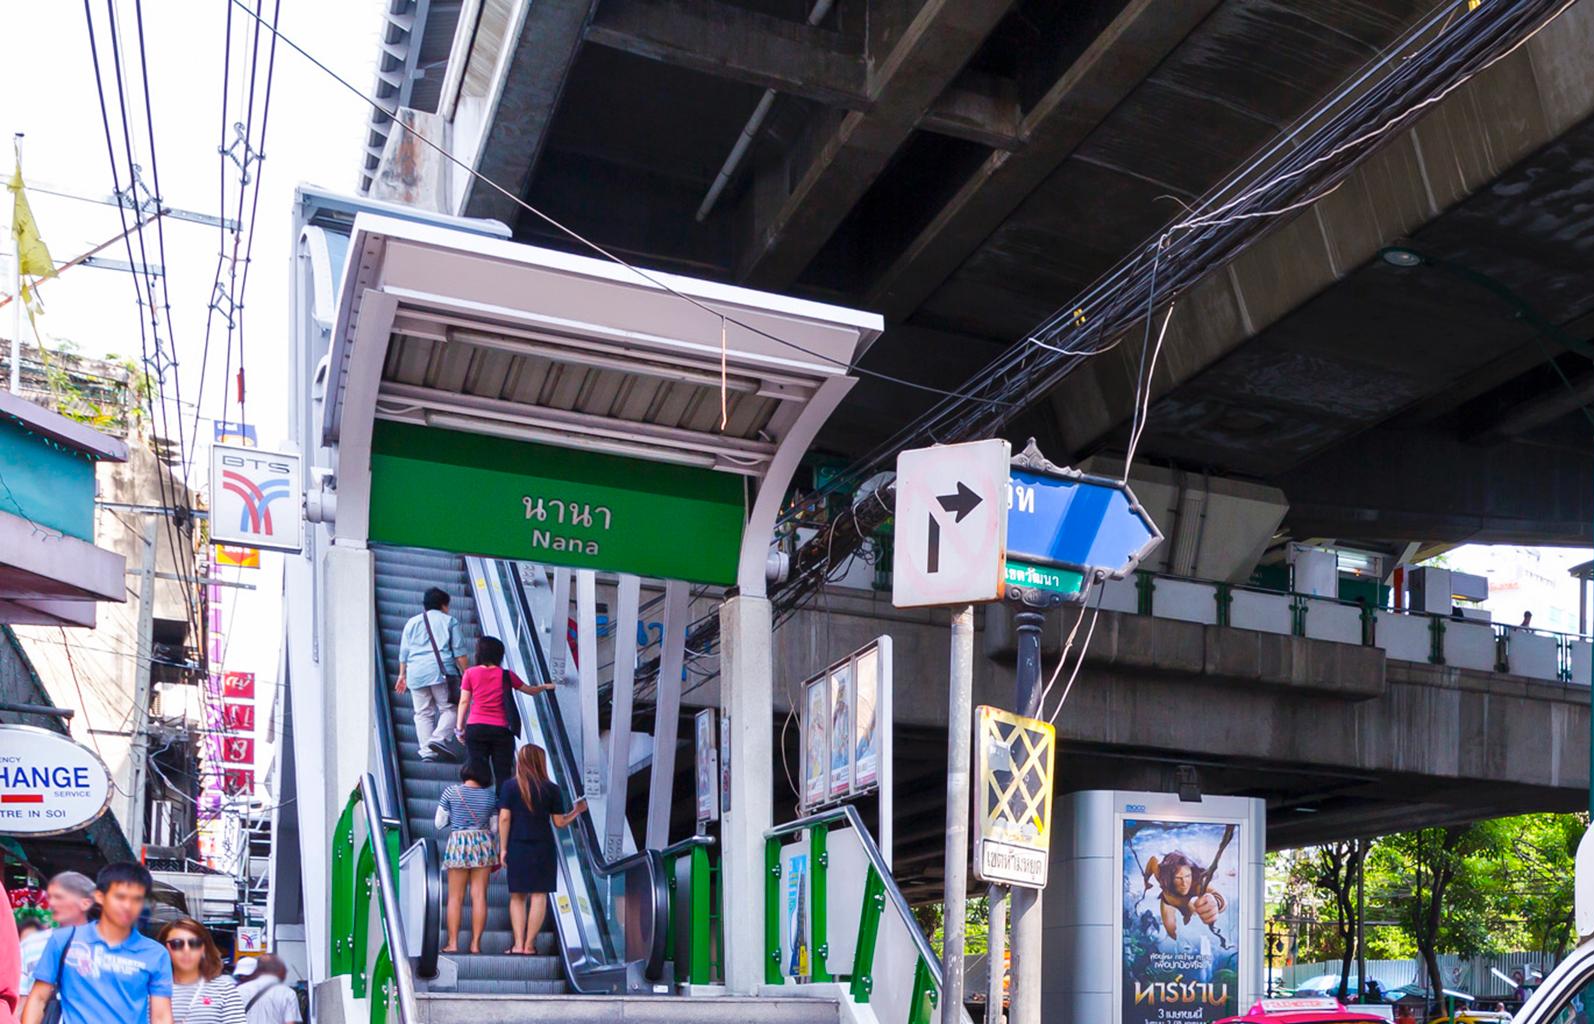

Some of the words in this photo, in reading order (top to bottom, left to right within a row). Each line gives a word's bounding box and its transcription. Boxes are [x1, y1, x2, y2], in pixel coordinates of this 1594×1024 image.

[222, 455, 290, 475] BTS
[522, 496, 611, 530] นานา
[532, 528, 599, 555] Nana
[54, 790, 91, 798] SERVICE
[28, 809, 40, 818] IN
[46, 809, 66, 818] SOI
[1158, 1008, 1164, 1019] 3
